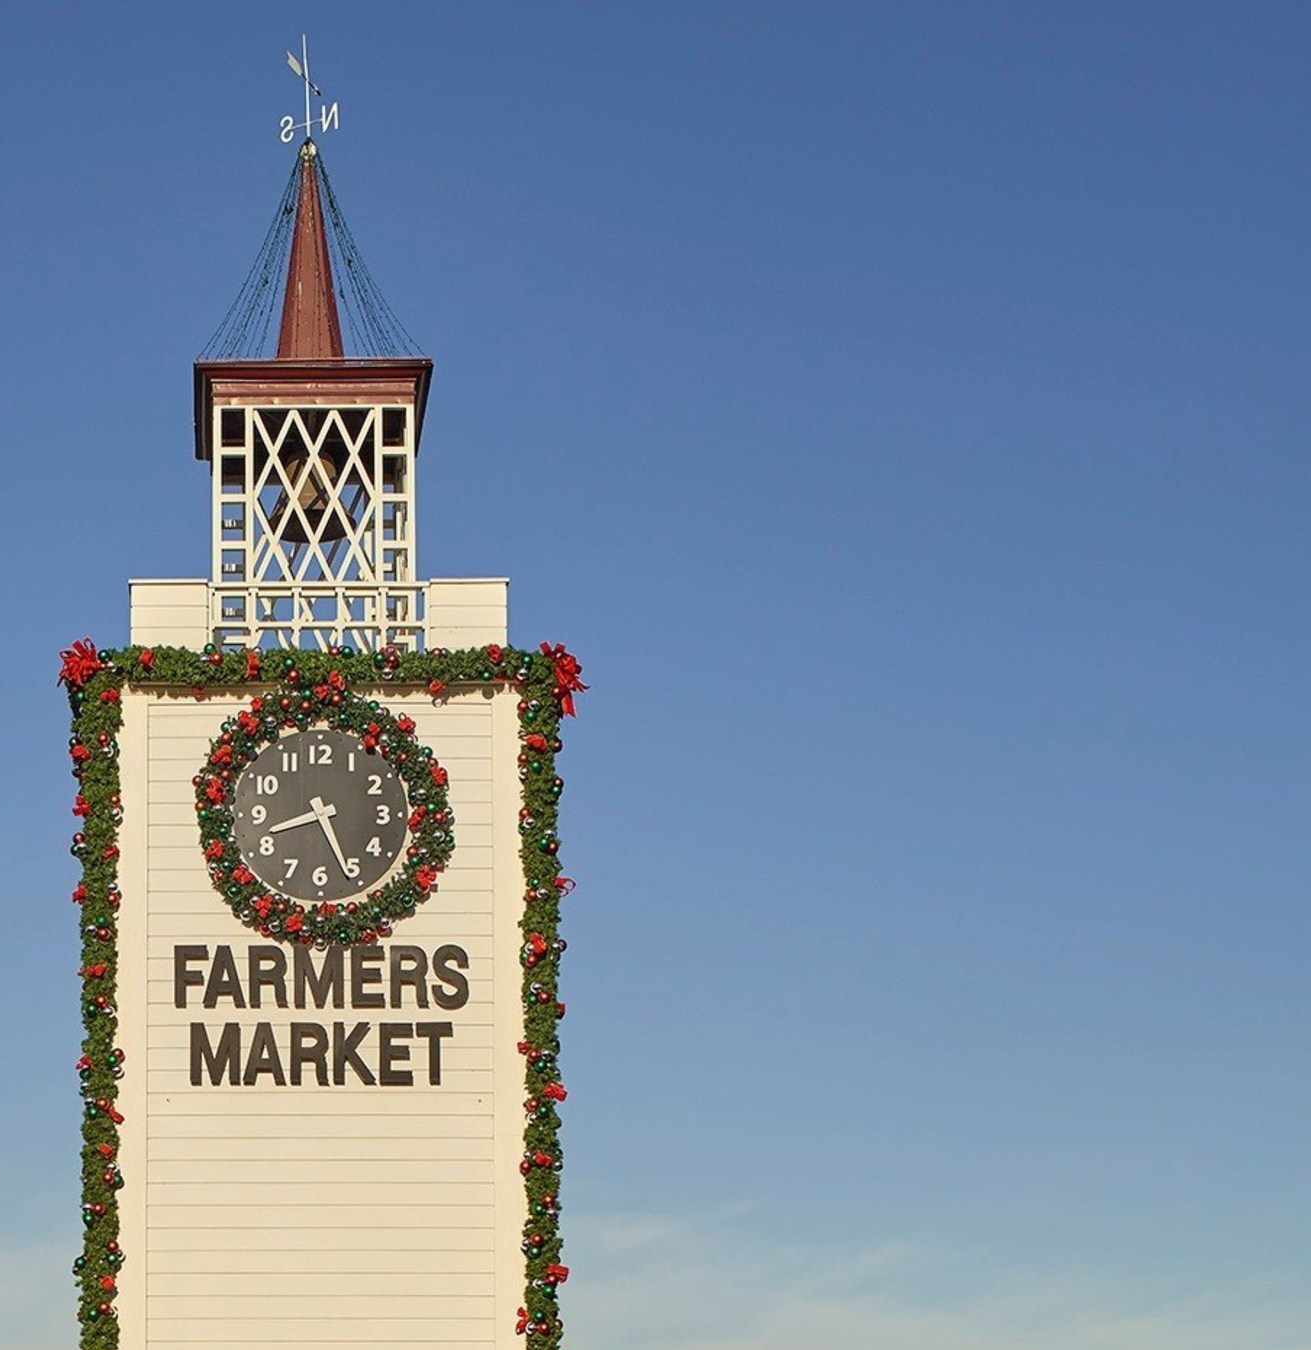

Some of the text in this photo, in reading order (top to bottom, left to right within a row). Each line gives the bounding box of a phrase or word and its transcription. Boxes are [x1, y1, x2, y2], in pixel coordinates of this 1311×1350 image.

[282, 752, 298, 772] 11
[309, 744, 333, 765] 12
[348, 752, 355, 772] 1
[256, 774, 279, 795] 10
[367, 774, 383, 795] 2
[251, 804, 267, 825] 9
[375, 804, 391, 825] 3
[259, 835, 275, 856] 8
[365, 837, 382, 857] 4
[283, 858, 299, 879] 7
[312, 866, 328, 887] 6
[345, 858, 361, 878] 5
[173, 944, 471, 1010] FARMERS
[189, 1021, 454, 1087] MARKET
